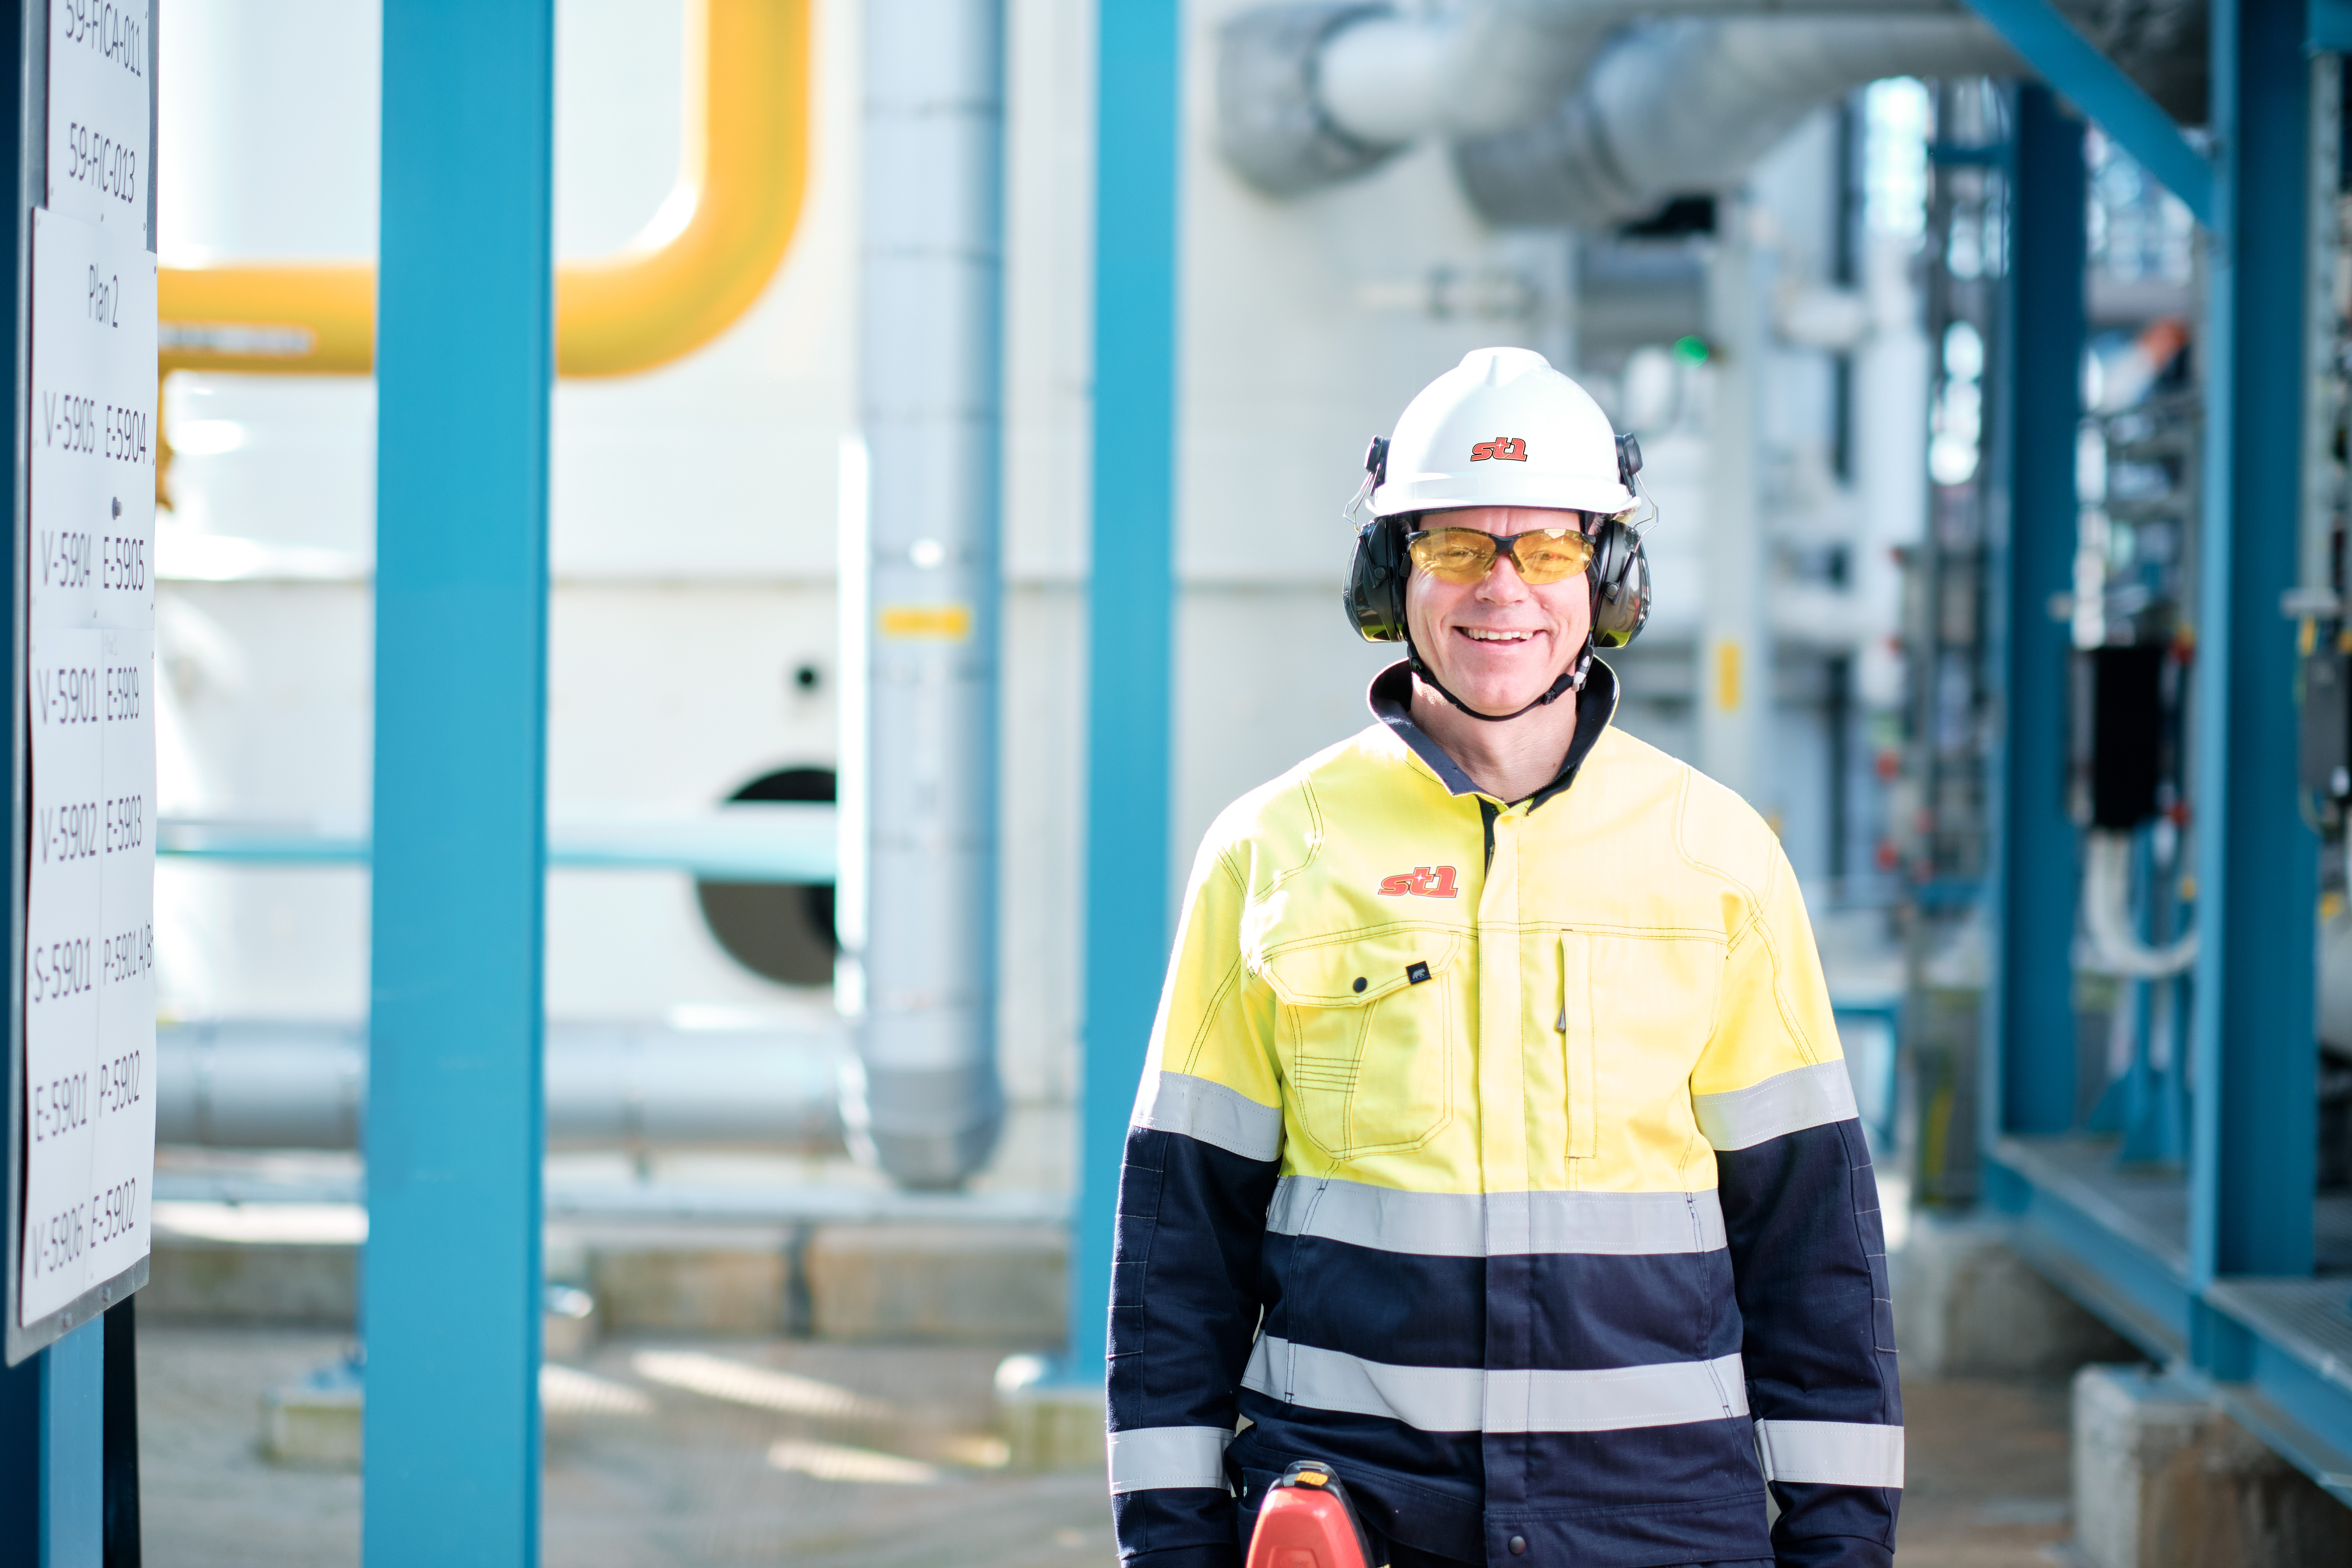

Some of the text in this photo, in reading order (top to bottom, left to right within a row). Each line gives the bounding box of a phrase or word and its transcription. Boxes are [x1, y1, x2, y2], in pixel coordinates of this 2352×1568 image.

[65, 0, 141, 78] 59-FICA-011
[69, 122, 135, 204] 59-FIC-013
[88, 263, 118, 328] Plan 2
[43, 391, 146, 464] V-5905 E-5904
[41, 530, 144, 591] V-5904 E-5905
[37, 667, 139, 724] V-5901 E-5909
[40, 795, 142, 864] V-5902 E-5903
[35, 919, 152, 1003] S-5901 P-5901 A/B
[36, 1049, 140, 1142] E-5901 P-5902
[32, 1178, 136, 1279] V-5906 E-5902
